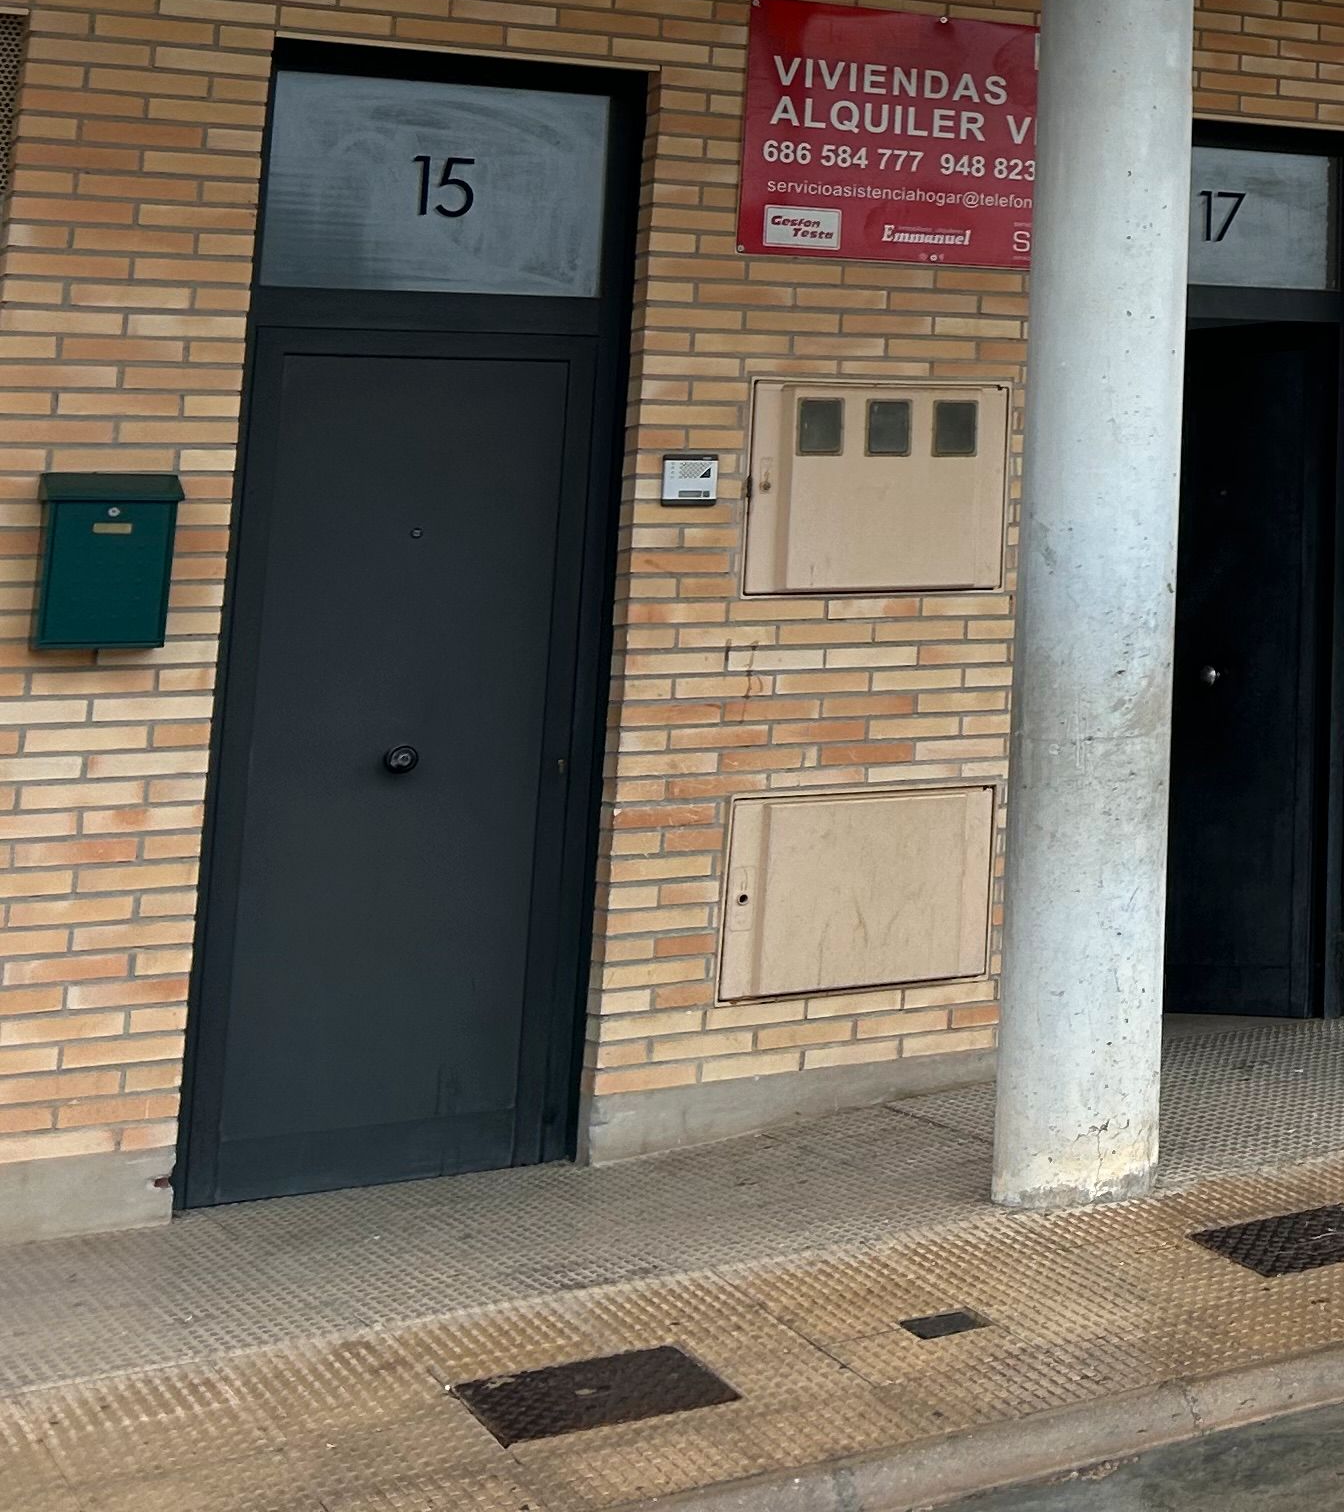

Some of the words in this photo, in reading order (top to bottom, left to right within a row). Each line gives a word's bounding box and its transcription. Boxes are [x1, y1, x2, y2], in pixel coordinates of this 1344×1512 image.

[773, 55, 1008, 105] VIVIENDAS
[770, 95, 985, 142] ALQUILER
[1006, 115, 1037, 145] V
[763, 140, 812, 166] 686
[820, 144, 868, 169] 584
[877, 149, 924, 172] 777
[940, 154, 986, 177] 948
[993, 159, 1036, 181] 823
[413, 155, 475, 218] 15
[881, 224, 971, 246] Emmanuel
[1198, 190, 1246, 242] 17
